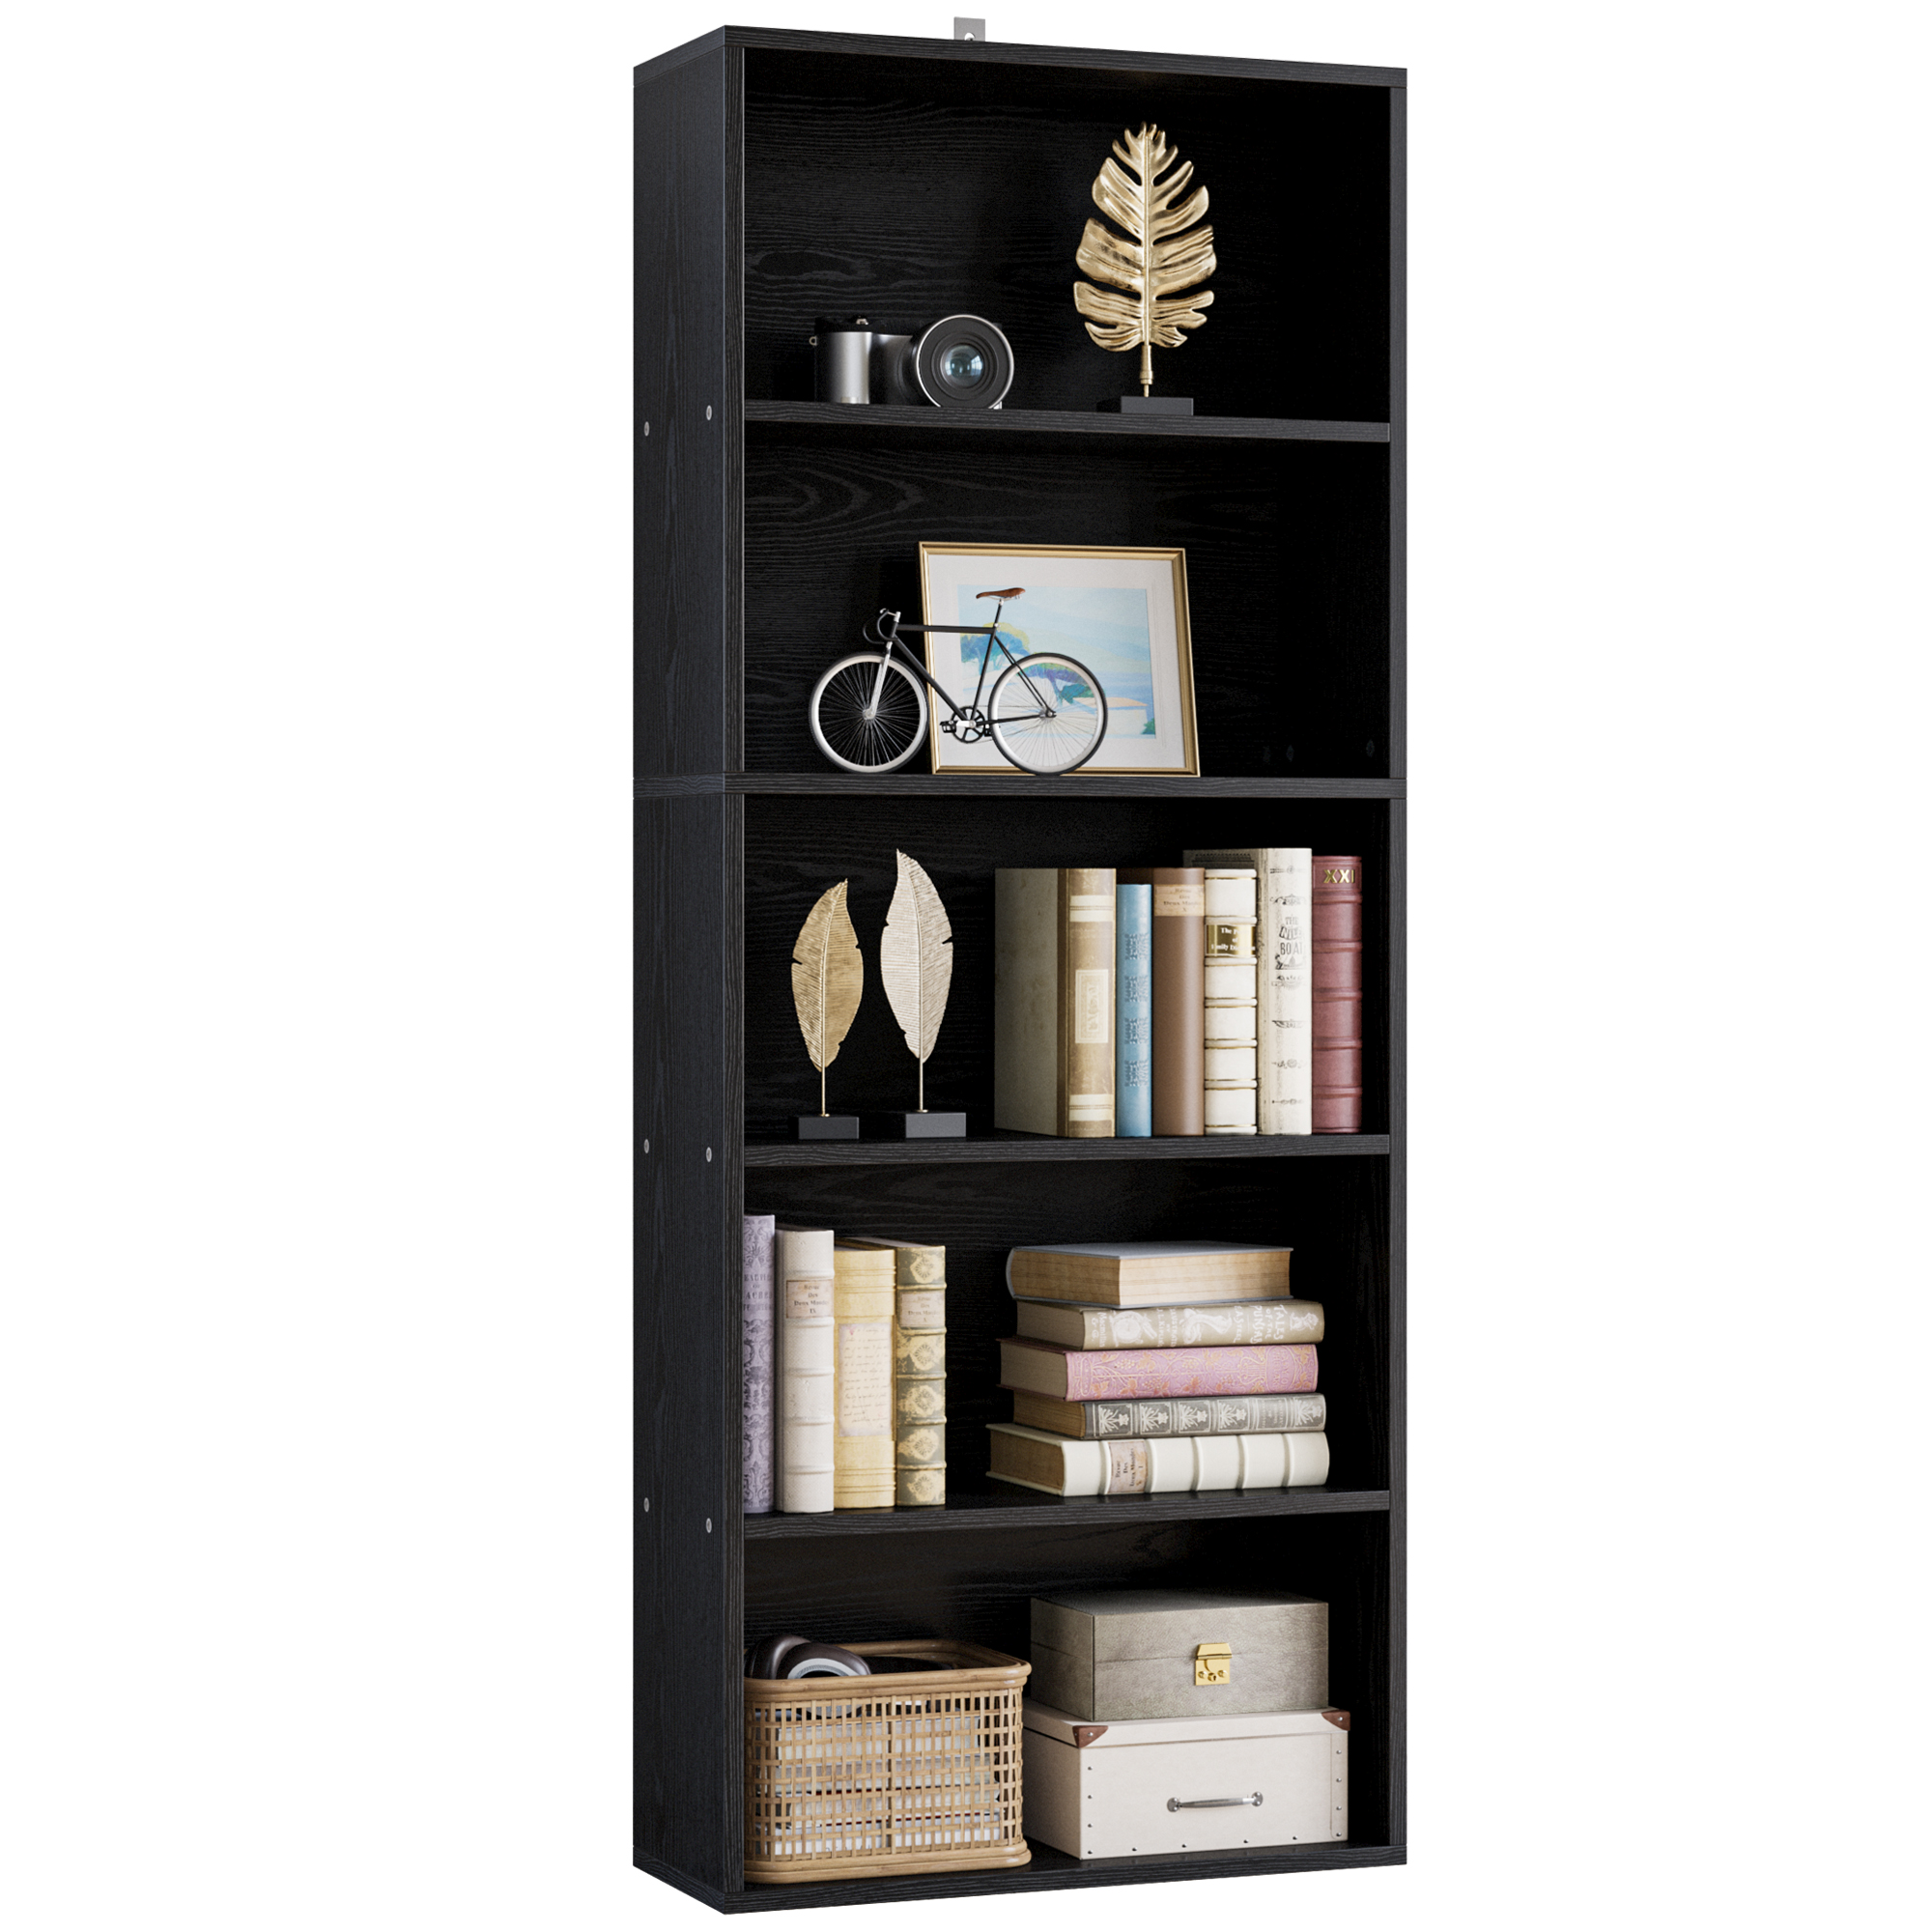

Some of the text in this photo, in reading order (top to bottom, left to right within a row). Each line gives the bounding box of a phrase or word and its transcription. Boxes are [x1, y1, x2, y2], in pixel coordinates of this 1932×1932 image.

[1323, 868, 1355, 884] XXI
[1285, 916, 1299, 925] THE
[1280, 942, 1304, 955] BOAT
[1248, 1305, 1265, 1344] PUNJAB
[1273, 1304, 1288, 1340] TALES
